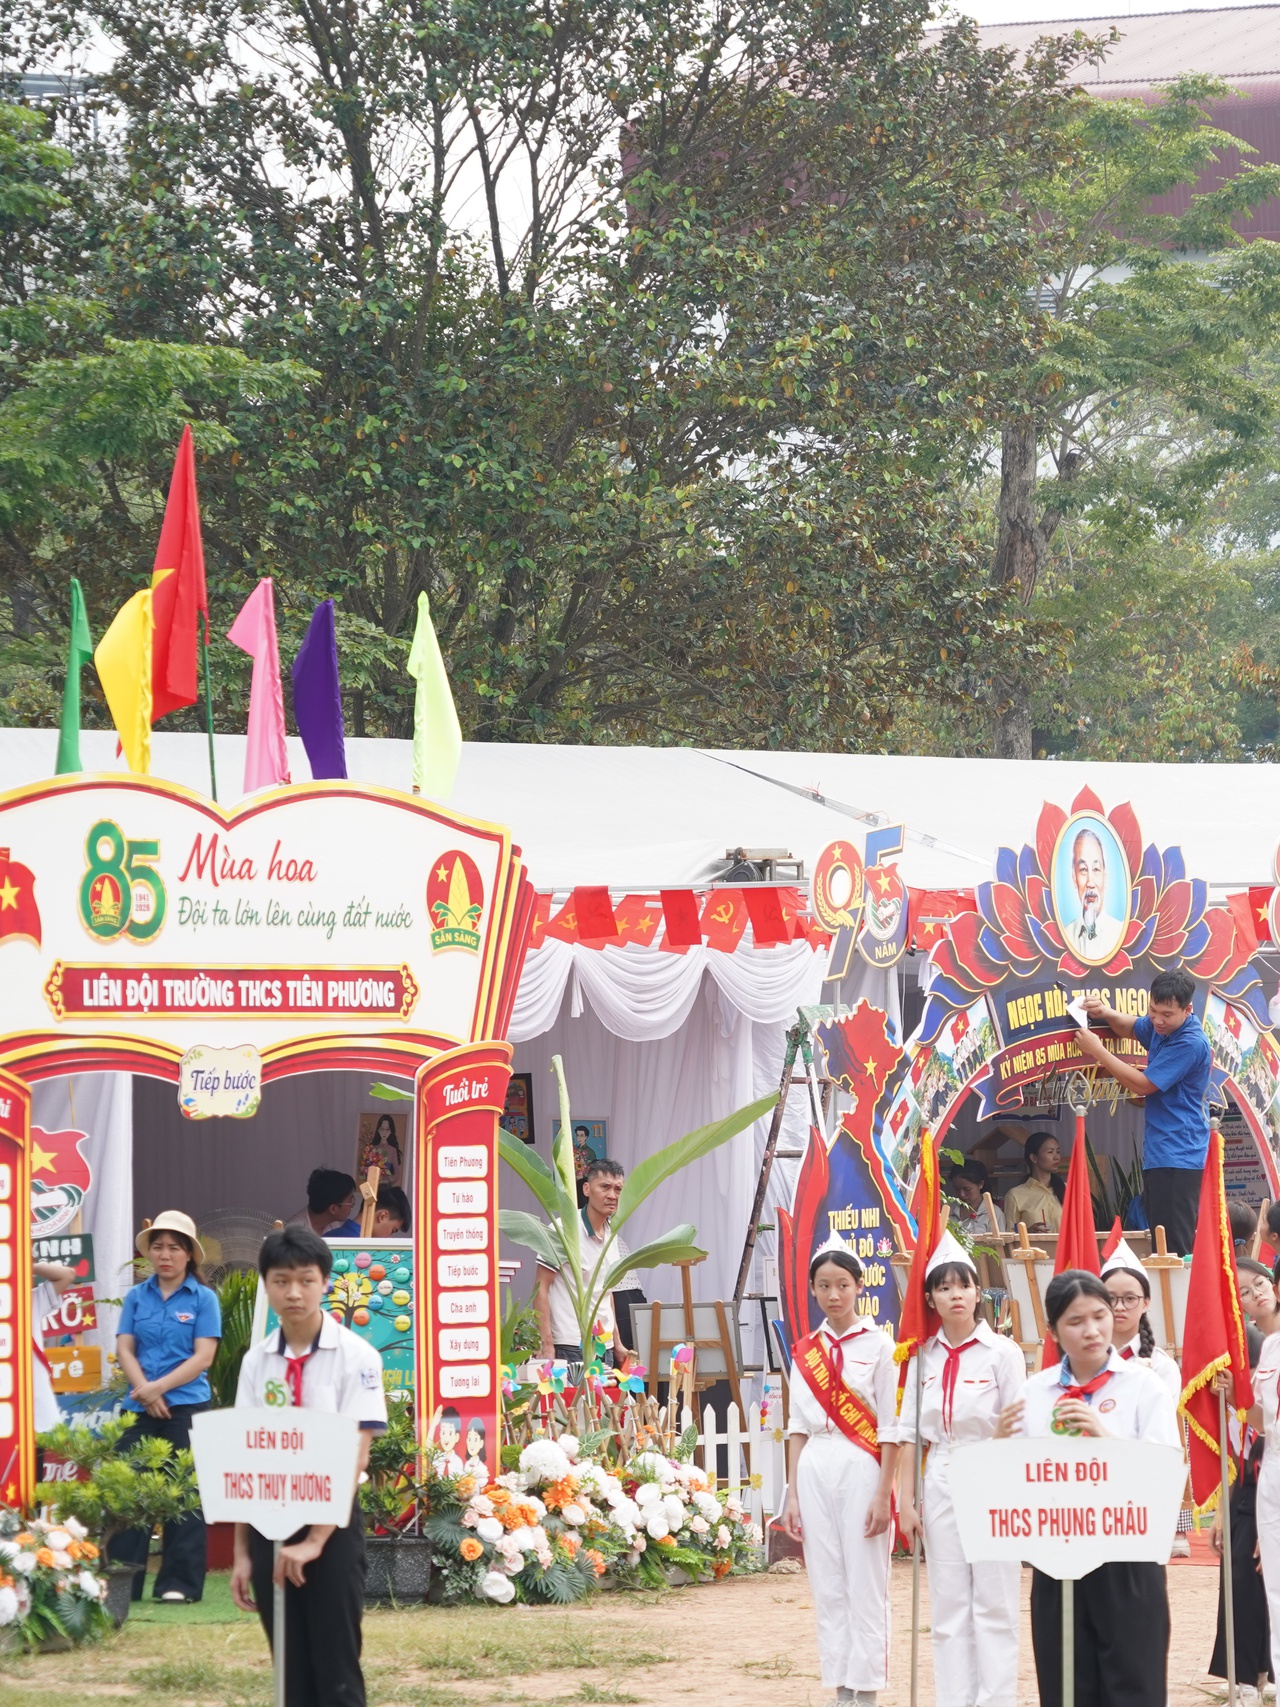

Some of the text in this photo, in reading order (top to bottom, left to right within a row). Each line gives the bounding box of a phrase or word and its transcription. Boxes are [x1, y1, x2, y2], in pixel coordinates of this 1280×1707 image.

[177, 832, 318, 887] Mùa hoa
[78, 818, 168, 946] 85
[135, 893, 150, 902] 1941
[177, 895, 413, 940] Đội ta lớn lên cùng đất nước
[454, 930, 477, 946] SÀNG
[875, 943, 897, 960] NĂM
[82, 972, 395, 1013] LIÊN ĐỘI TRƯỜNG THCS TIÊN PHƯƠNG
[1006, 995, 1044, 1031] NGỌC
[1000, 1053, 1012, 1080] KỶ
[1012, 1049, 1035, 1075] NIỆM
[1035, 1047, 1045, 1066] 85
[1047, 1040, 1065, 1063] MÙA
[1066, 1041, 1083, 1058] HOA
[190, 1067, 256, 1096] Tiếp bước
[443, 1077, 489, 1106] Tuổi trẻ
[444, 1156, 483, 1169] Tiên Phương
[828, 1203, 880, 1231] THIẾU NHI
[859, 1234, 874, 1258] ĐÔ
[450, 1302, 477, 1314] Cha anh
[858, 1292, 880, 1318] VÀO
[48, 1350, 84, 1379] rẻ
[264, 1380, 287, 1407] 85
[471, 1375, 480, 1387] lai
[804, 1346, 823, 1369] ĐỘI
[840, 1402, 865, 1426] CHÍ
[246, 1427, 304, 1455] LIÊN ĐỘI
[1025, 1457, 1108, 1486] LIÊN ĐỘI
[224, 1472, 254, 1500] THCS
[291, 1472, 331, 1502] HƯƠNG
[989, 1500, 1148, 1543] THCS PHỤNG CHÂU
